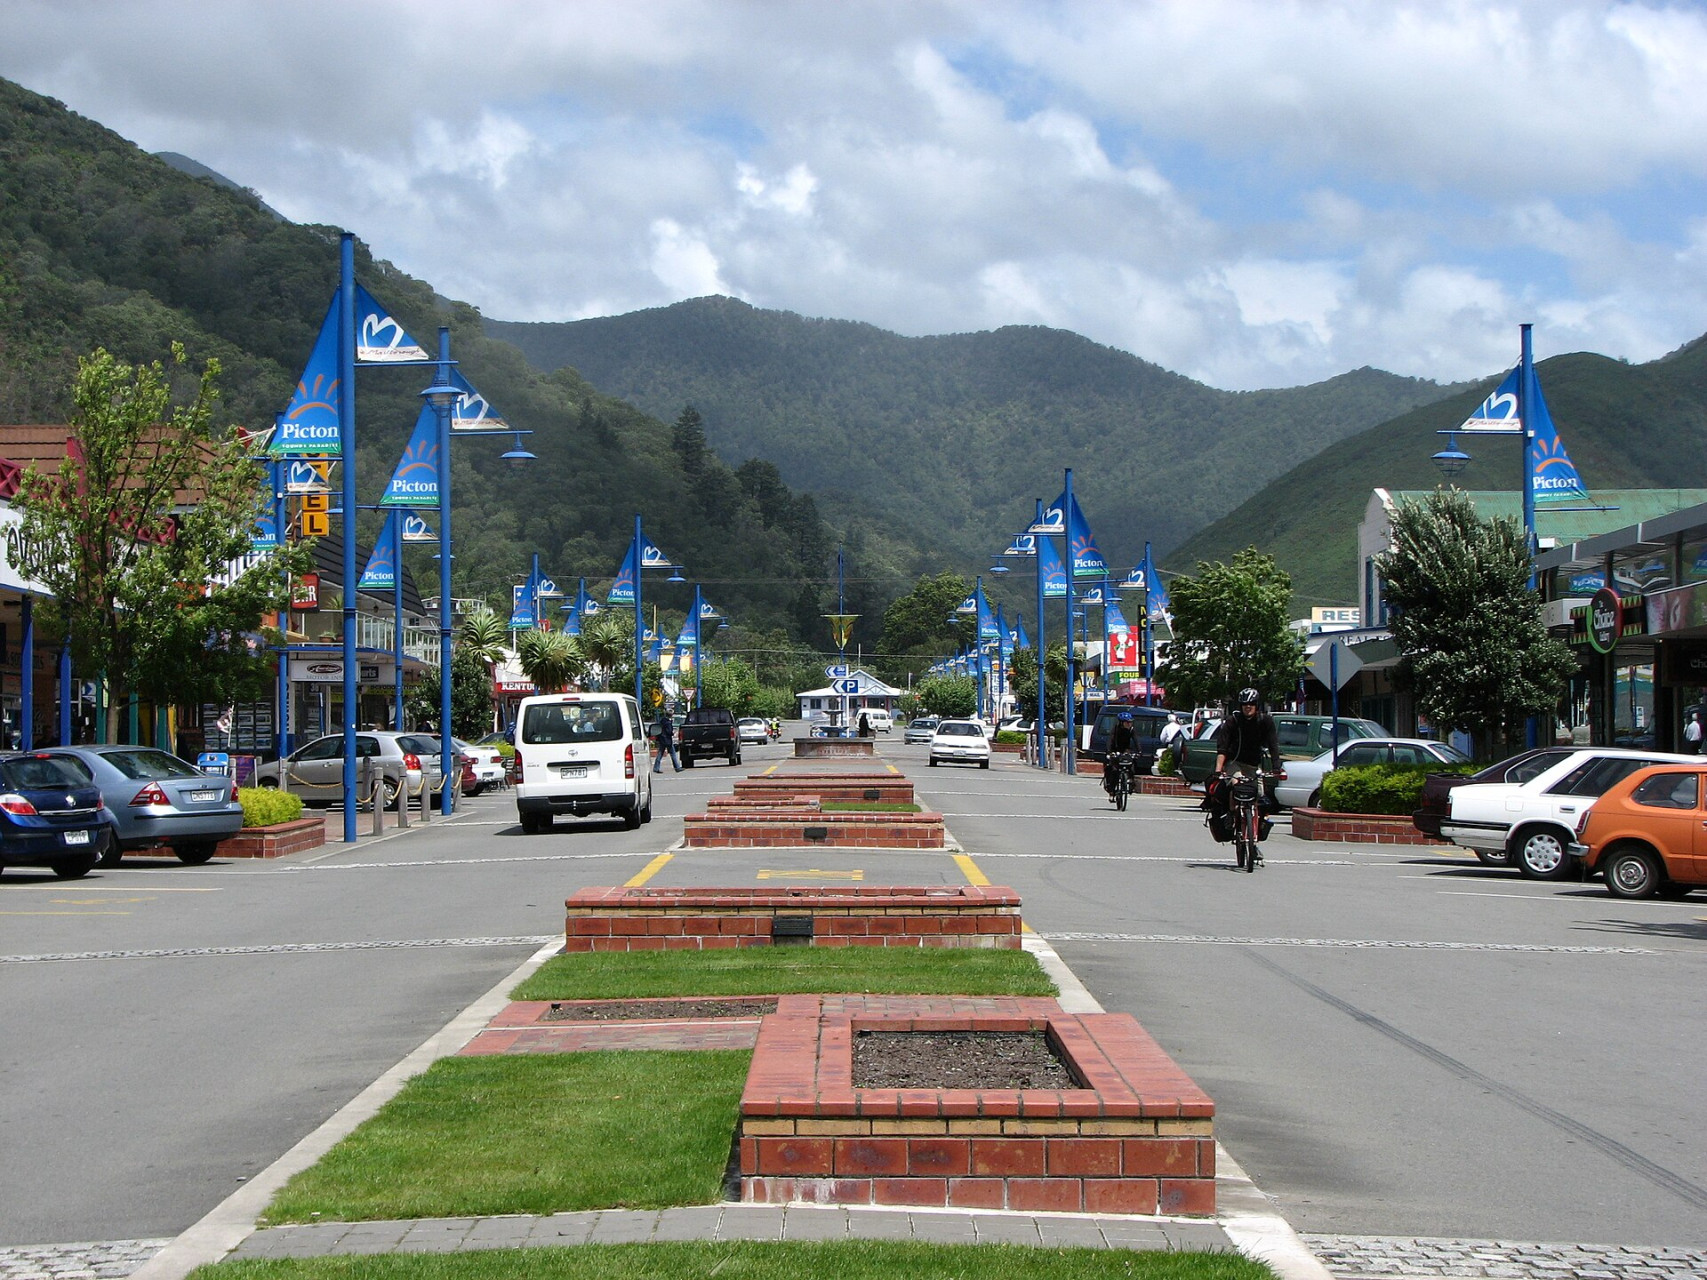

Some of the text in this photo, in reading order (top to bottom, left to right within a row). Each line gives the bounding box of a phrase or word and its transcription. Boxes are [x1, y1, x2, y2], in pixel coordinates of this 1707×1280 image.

[281, 424, 339, 438] Picton
[392, 480, 438, 492] Picton
[1532, 476, 1578, 489] Picton
[1074, 559, 1104, 568] Picton
[364, 571, 394, 580] Picton
[501, 682, 541, 691] KENTU
[846, 681, 856, 693] P
